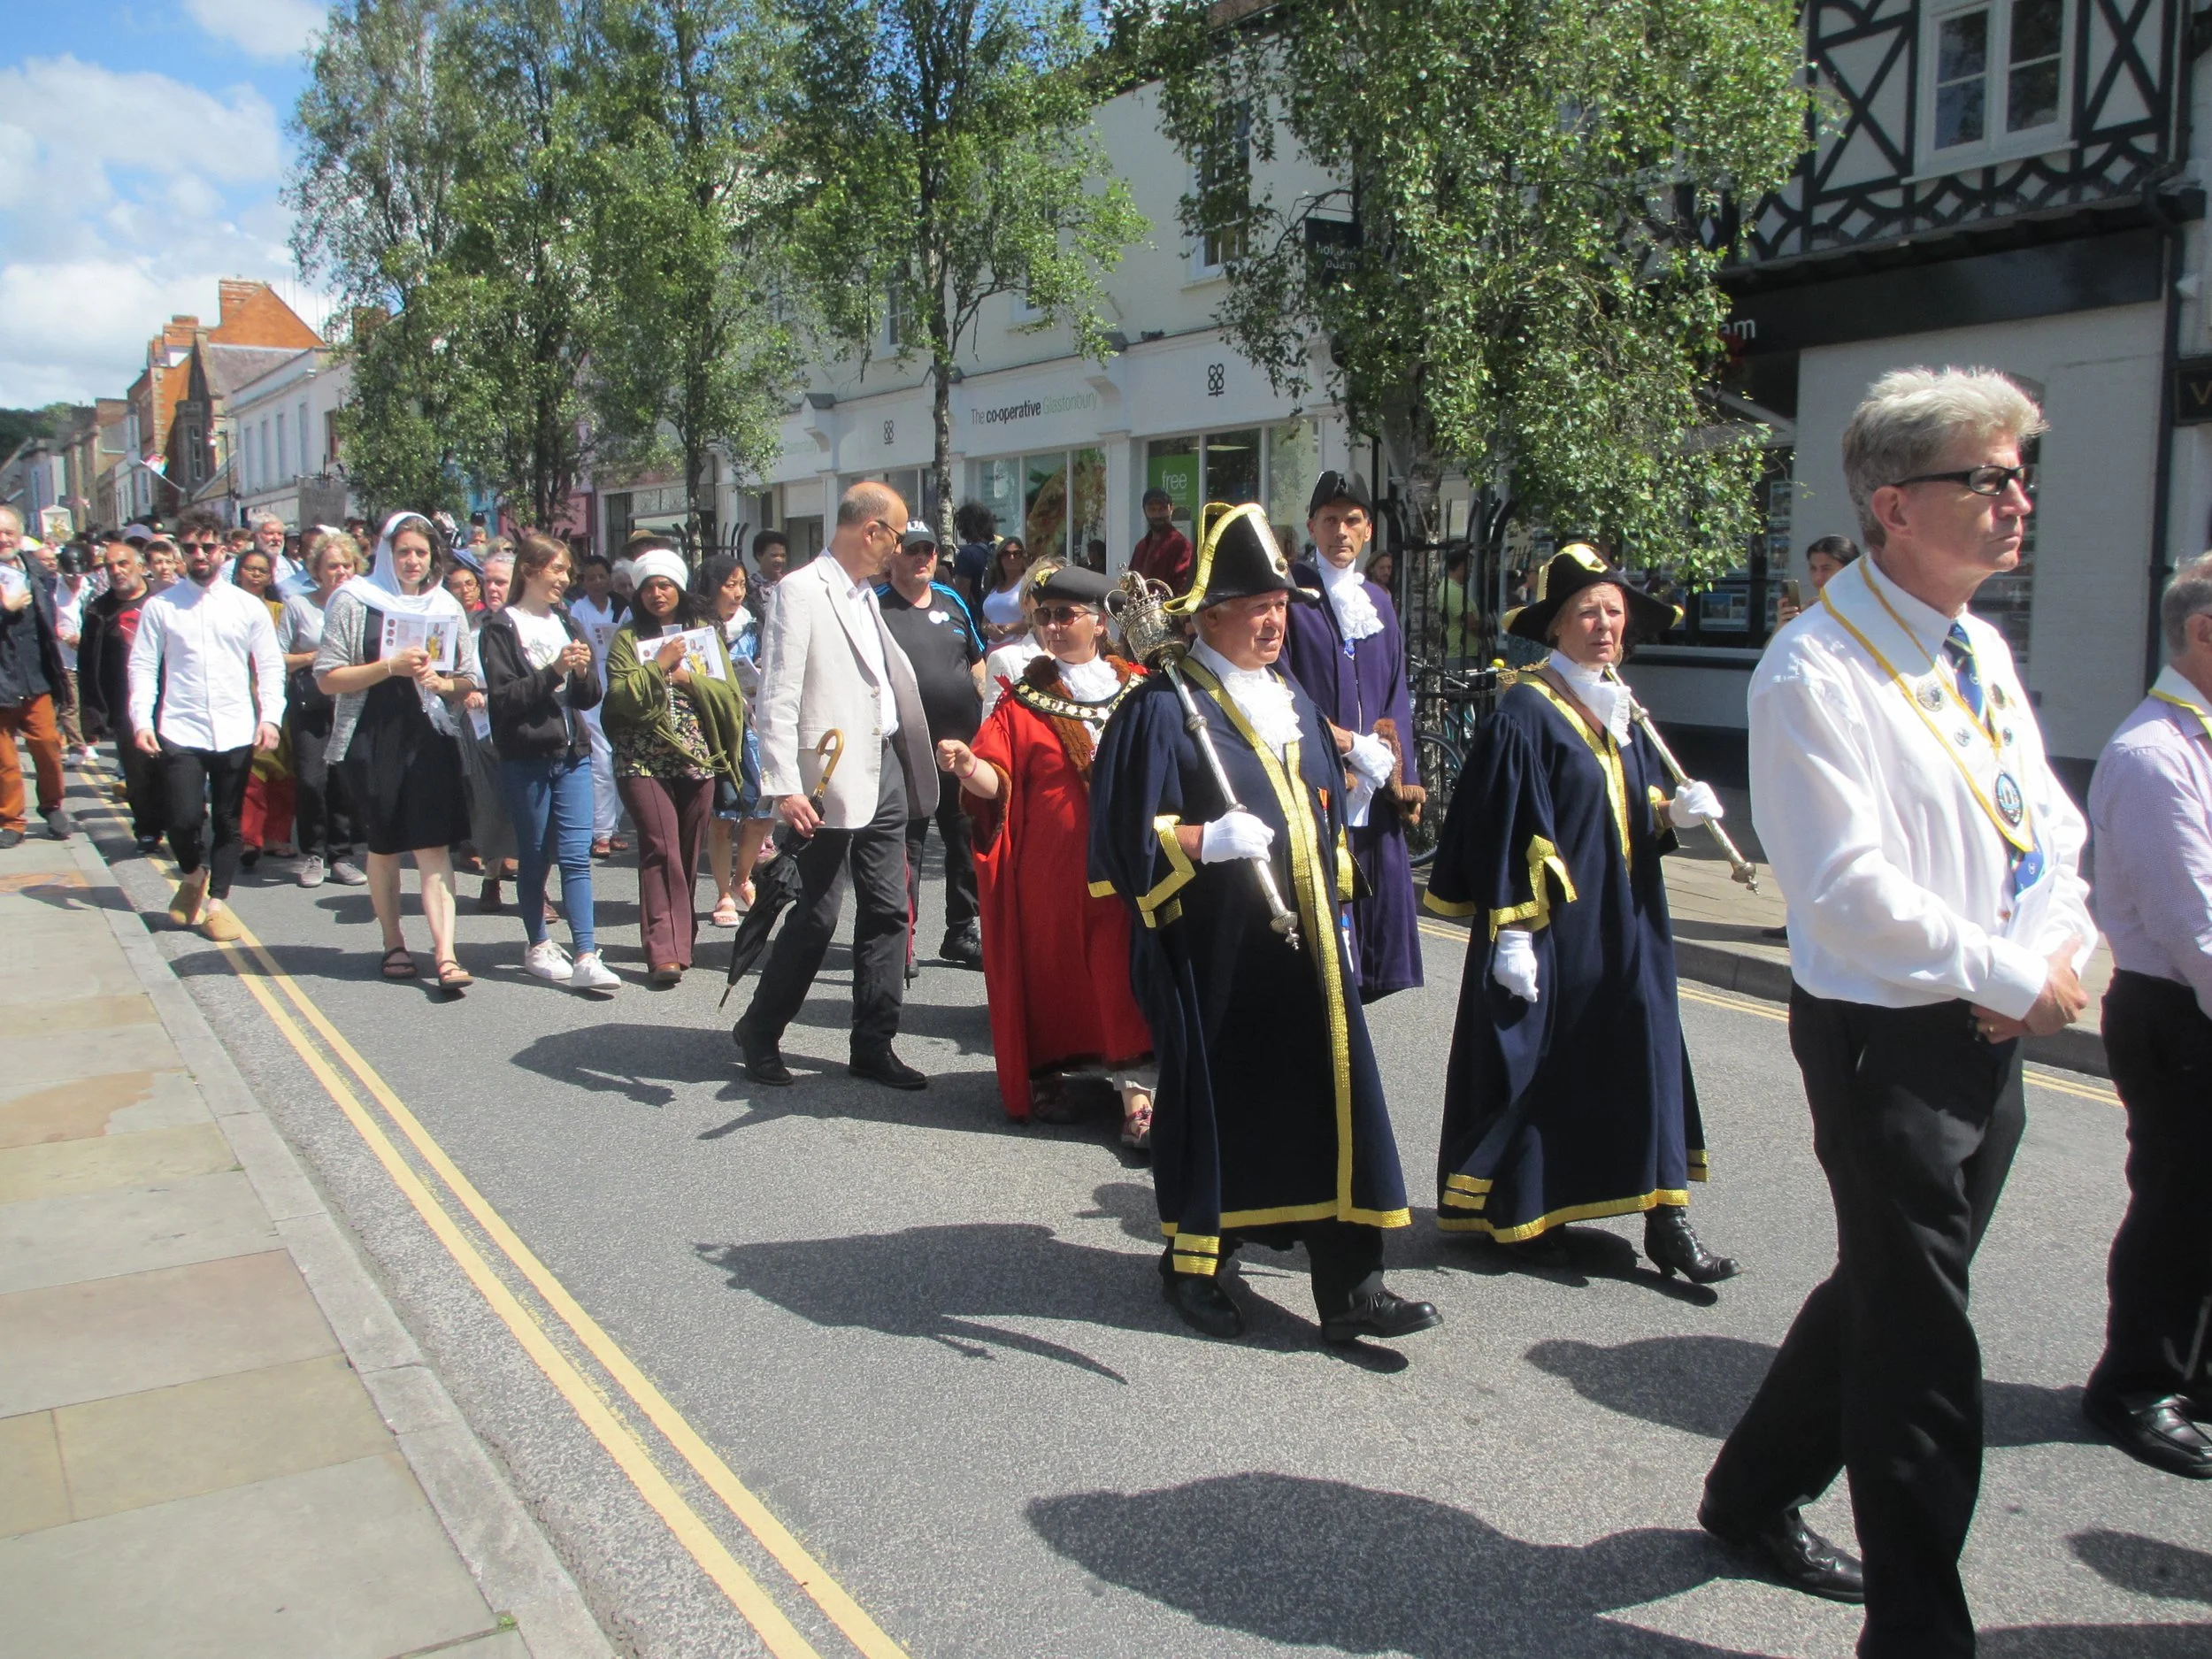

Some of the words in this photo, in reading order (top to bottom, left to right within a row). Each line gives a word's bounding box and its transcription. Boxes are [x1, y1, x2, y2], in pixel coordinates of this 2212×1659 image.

[971, 409, 985, 425] The
[986, 400, 1041, 424] co-operative
[1042, 391, 1098, 415] Glastonbury
[1162, 470, 1187, 489] free
